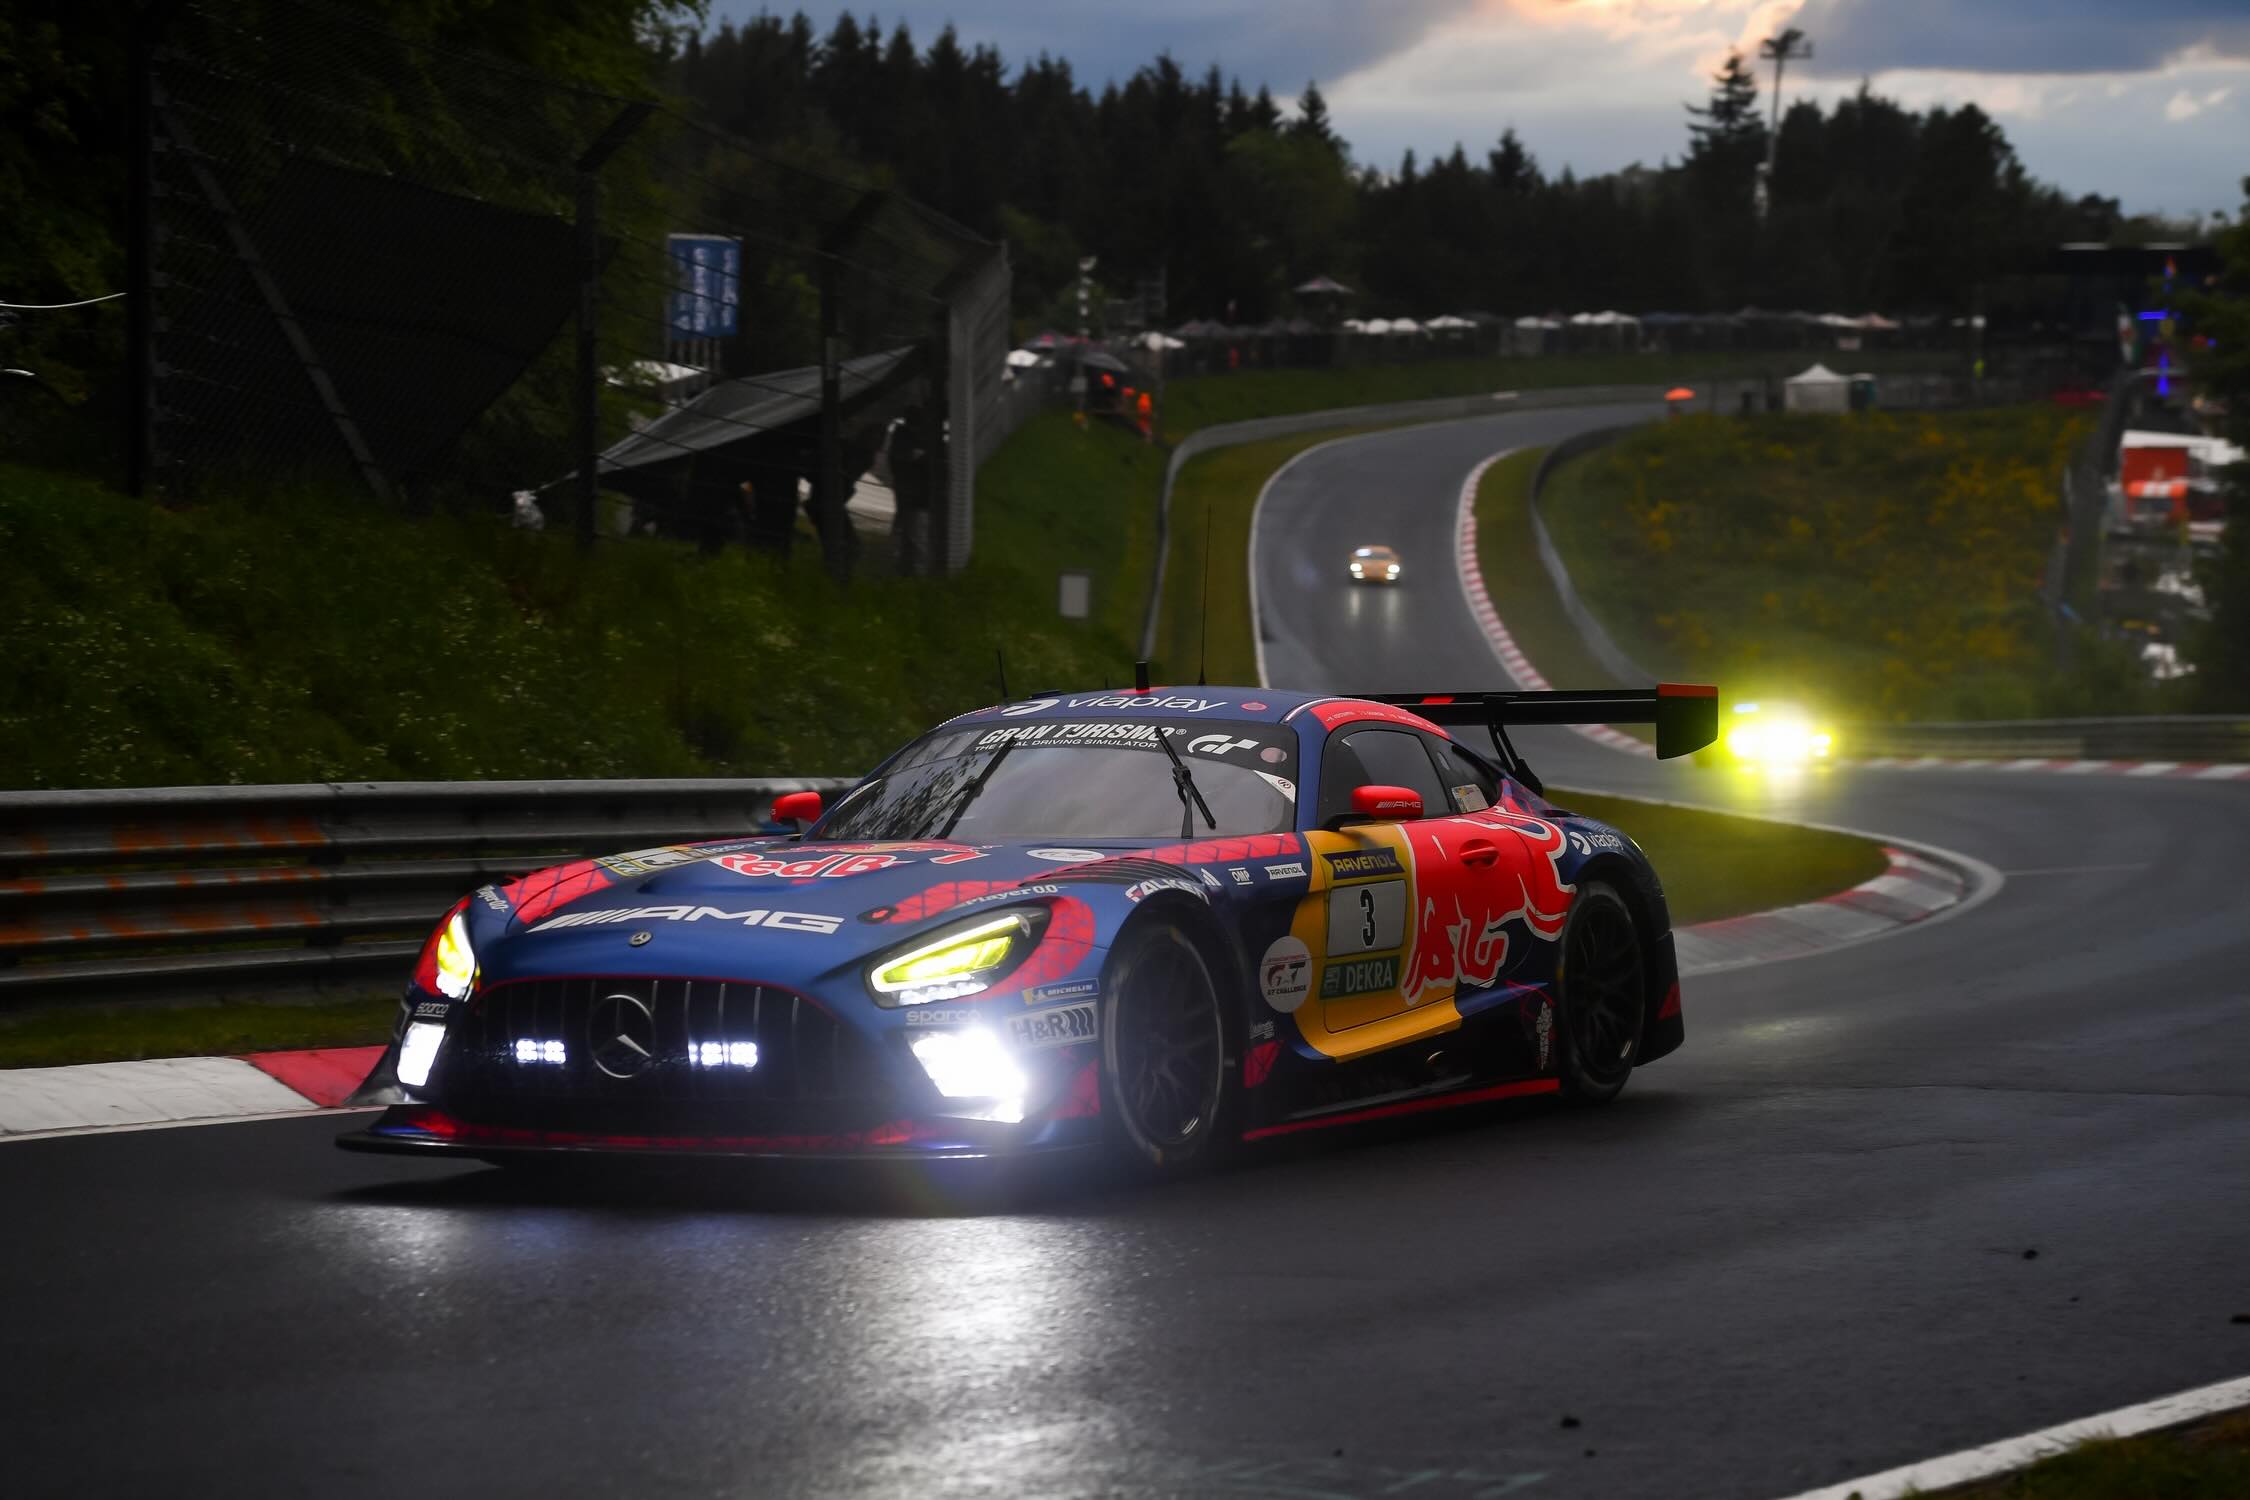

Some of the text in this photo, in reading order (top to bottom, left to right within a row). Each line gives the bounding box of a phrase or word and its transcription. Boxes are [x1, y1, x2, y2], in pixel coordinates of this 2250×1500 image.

[1068, 695, 1228, 713] viaplay
[979, 724, 1057, 745] GRAN
[975, 744, 996, 752] THE
[1031, 737, 1082, 746] DRIVING
[1084, 738, 1158, 749] SIMULATOR
[1393, 800, 1422, 809] AMG
[1584, 831, 1624, 851] viaplay
[709, 852, 852, 878] Red
[1269, 866, 1302, 876] RAVENOL
[1333, 854, 1397, 872] RAVENOL
[610, 905, 845, 935] AMG
[1359, 887, 1376, 948] 3
[1345, 959, 1393, 993] DEKRA
[1048, 984, 1093, 996] MICHELIN
[906, 1009, 982, 1025] sparco
[1011, 1011, 1067, 1042] H&R
